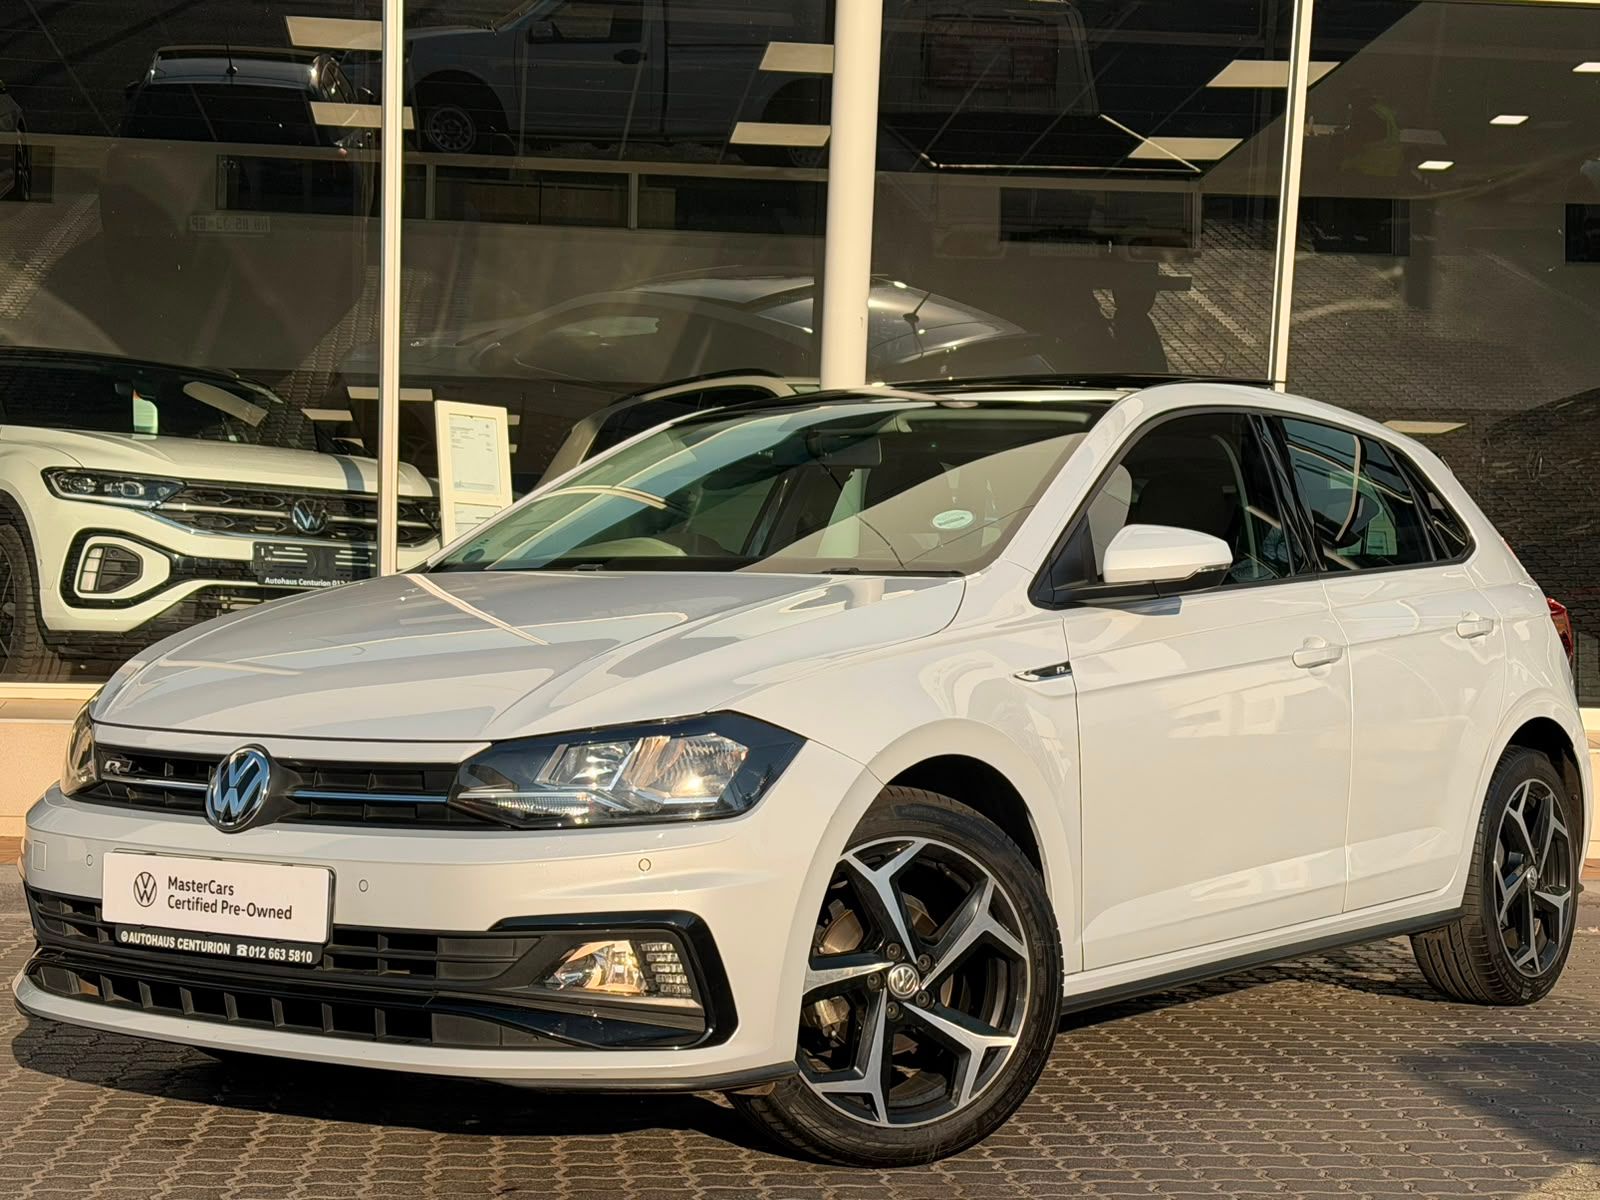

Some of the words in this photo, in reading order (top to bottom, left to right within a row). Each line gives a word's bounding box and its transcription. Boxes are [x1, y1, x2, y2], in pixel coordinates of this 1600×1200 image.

[265, 577, 297, 585] Autohaus
[299, 579, 331, 587] Centurion
[167, 875, 235, 896] MasterCars
[167, 894, 218, 914] Certified
[221, 900, 292, 920] Pre-Owned
[128, 932, 175, 948] AUTOHAUS
[177, 937, 231, 955] CENTURION
[248, 945, 266, 959] 012
[268, 947, 286, 961] 663
[288, 949, 313, 964] 5810
